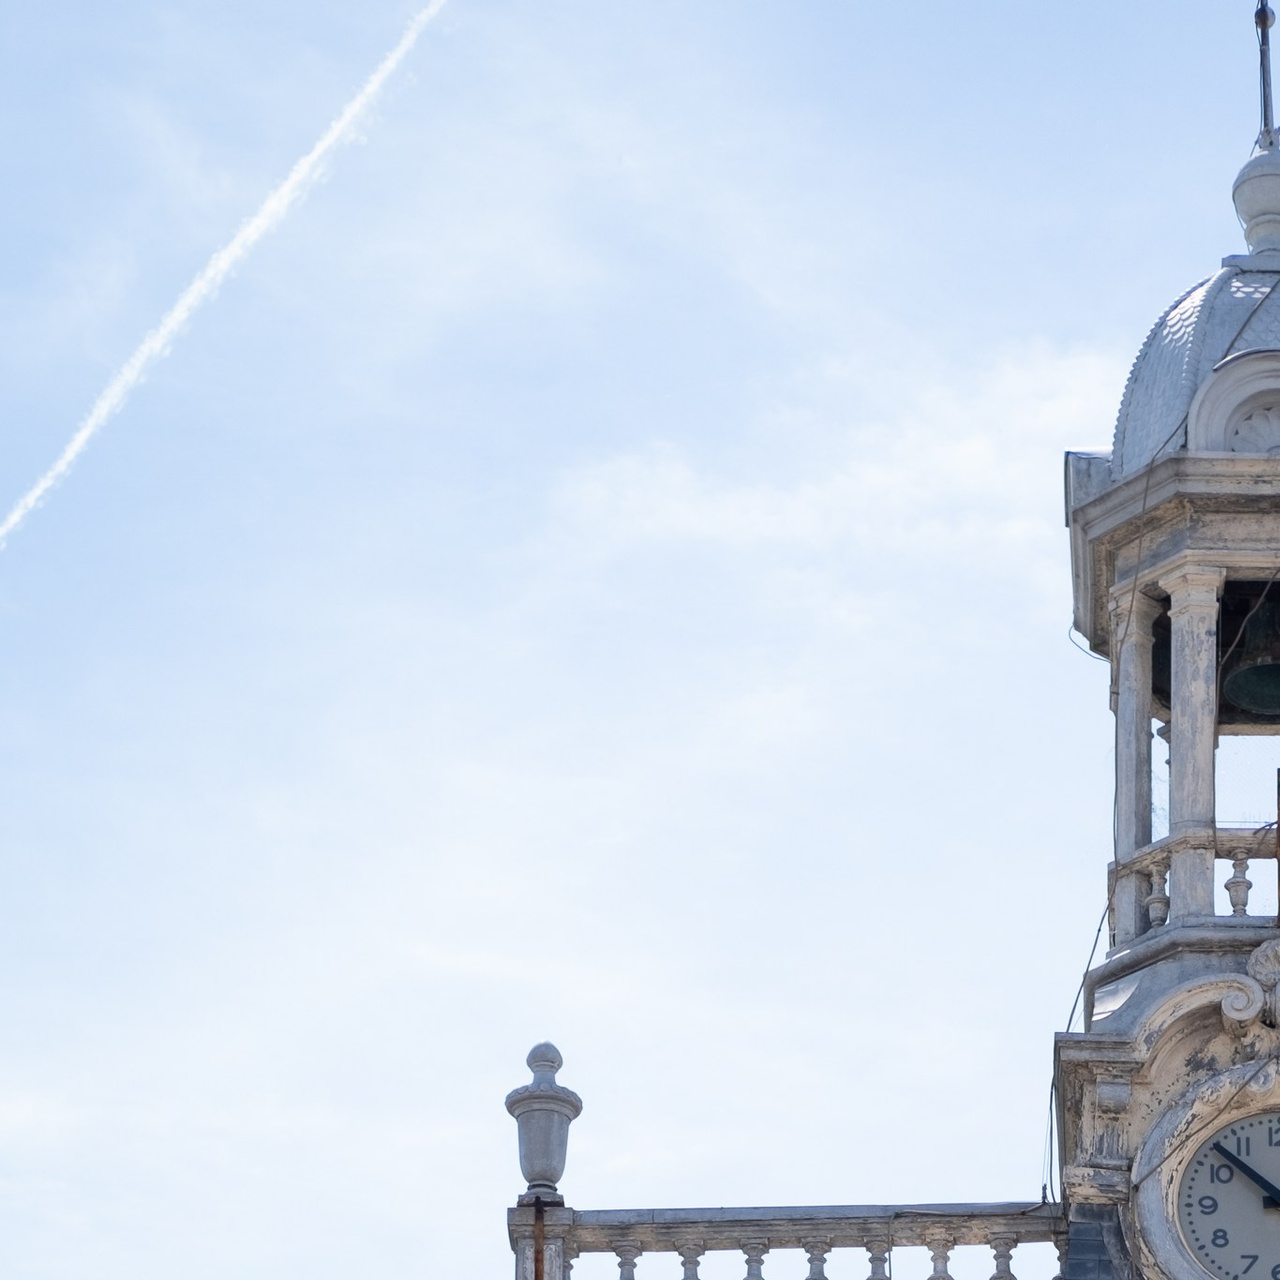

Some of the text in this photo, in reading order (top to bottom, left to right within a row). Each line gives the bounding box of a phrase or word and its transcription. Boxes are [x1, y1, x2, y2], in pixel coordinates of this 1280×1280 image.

[1236, 1136, 1250, 1157] 11
[1209, 1164, 1235, 1184] 10
[1198, 1196, 1218, 1215] 9
[1211, 1229, 1230, 1248] 8
[1240, 1255, 1259, 1275] 7
